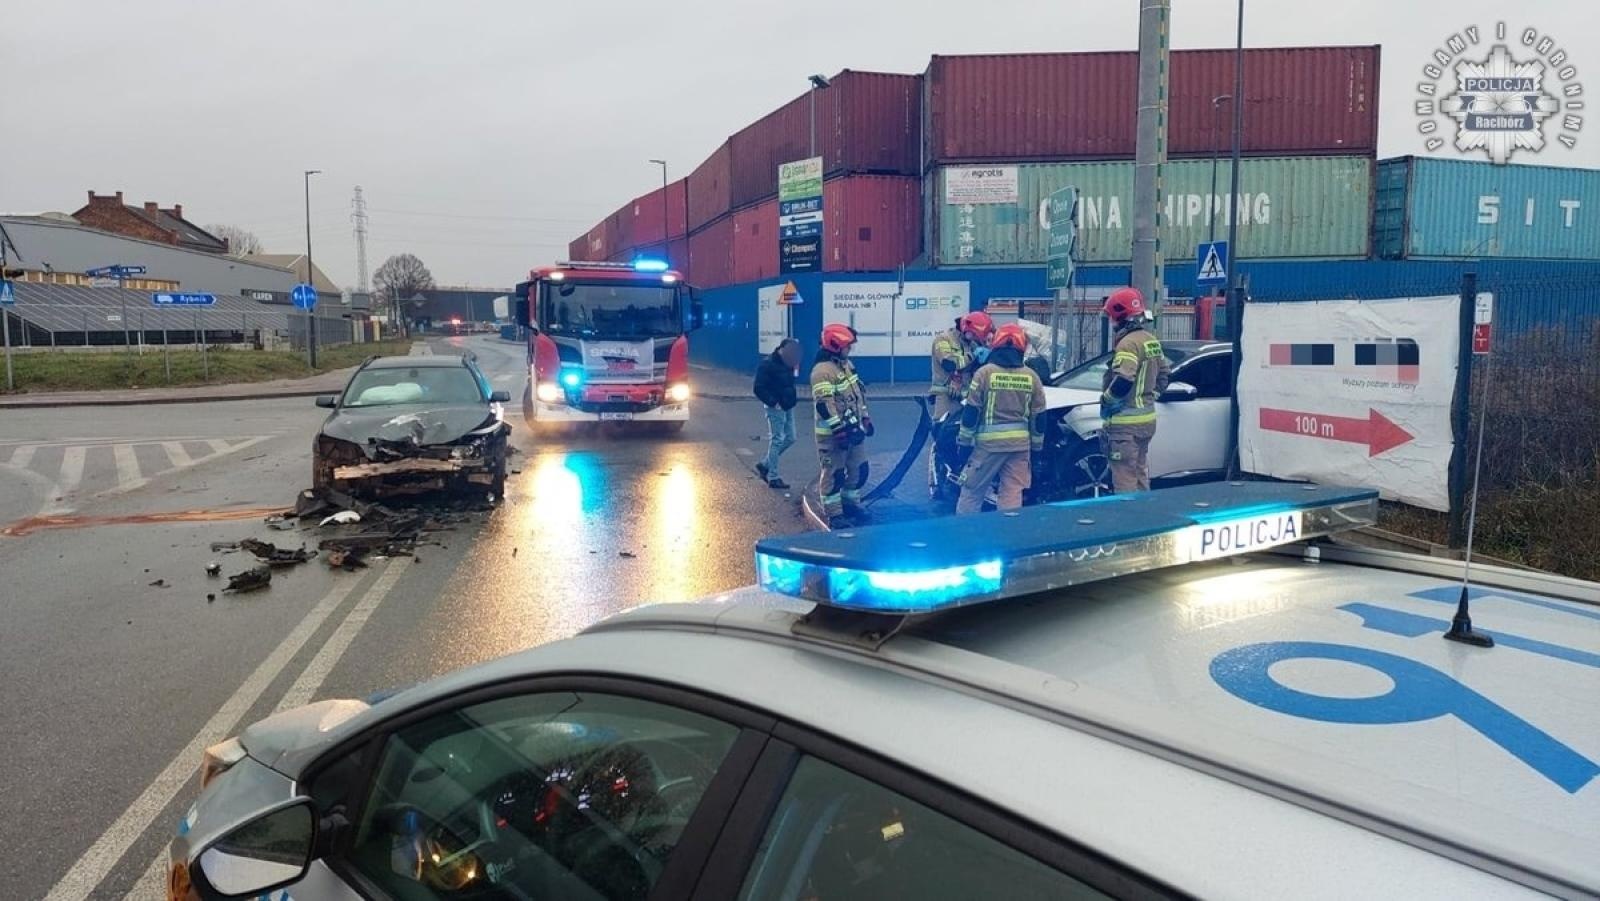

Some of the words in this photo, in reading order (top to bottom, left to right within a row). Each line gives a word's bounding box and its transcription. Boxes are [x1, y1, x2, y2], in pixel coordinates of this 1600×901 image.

[1039, 197, 1122, 230] CINA
[1164, 192, 1270, 229] HIPPING
[1295, 415, 1317, 434] 100
[1321, 423, 1334, 437] m
[1201, 514, 1297, 555] POLICJA
